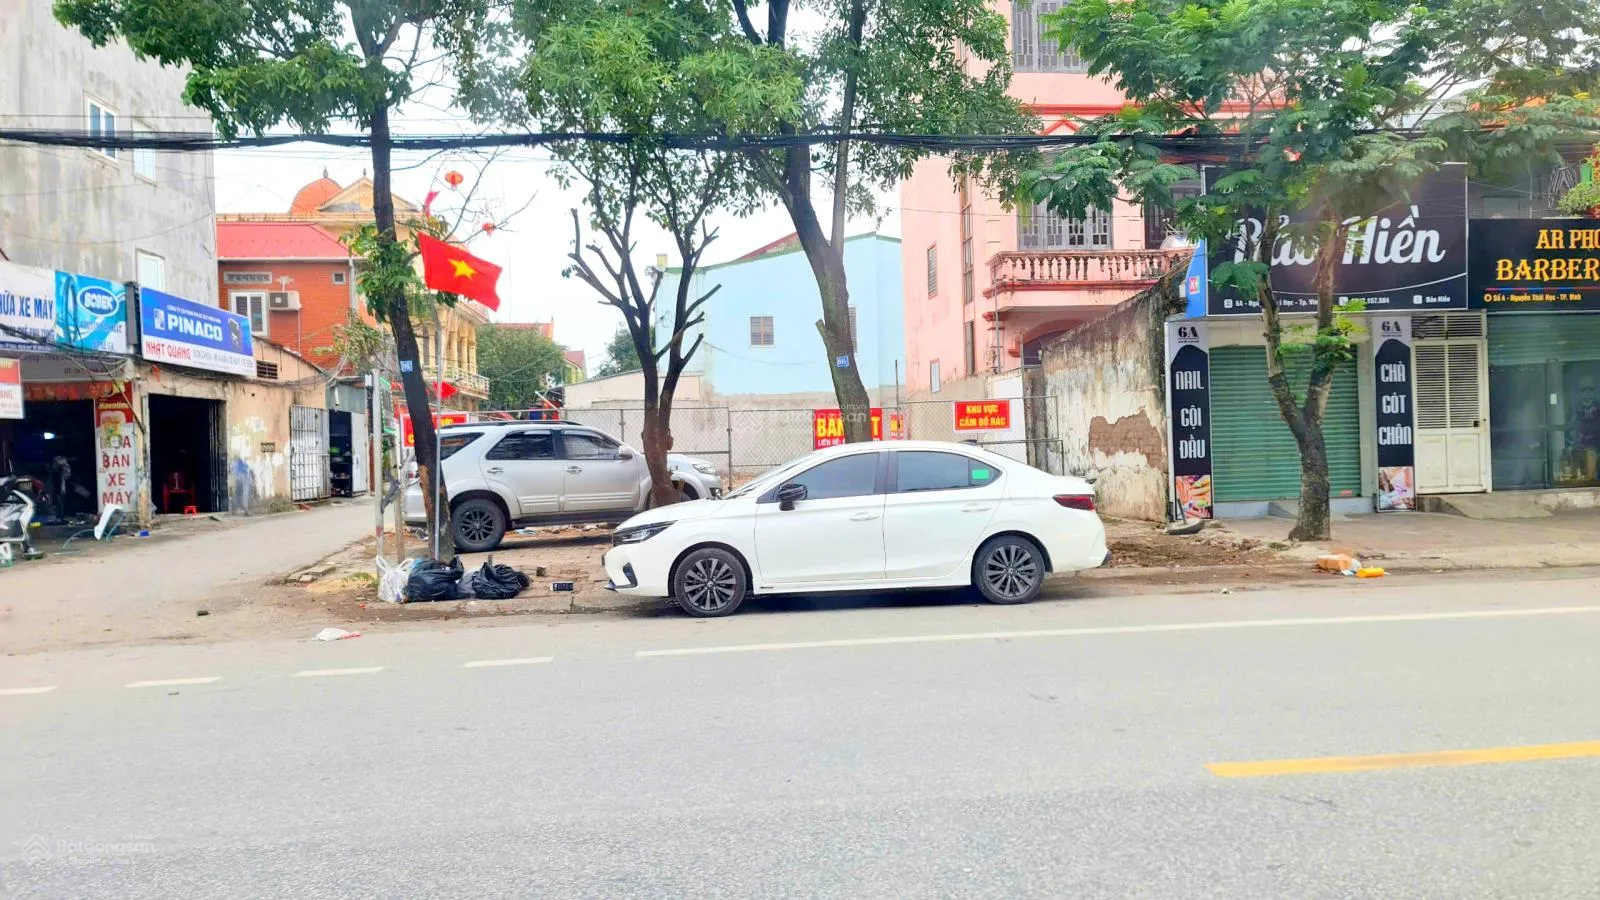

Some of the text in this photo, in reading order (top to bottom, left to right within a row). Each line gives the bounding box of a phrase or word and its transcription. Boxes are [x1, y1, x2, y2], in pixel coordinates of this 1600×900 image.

[1337, 205, 1447, 266] Hiền
[1535, 229, 1565, 249] AR
[1495, 258, 1600, 281] BARBER
[19, 296, 31, 318] XE
[34, 294, 54, 320] MÁY
[1569, 293, 1582, 301] Vinh
[167, 313, 223, 341] PINACO
[1178, 326, 1198, 338] 6A
[1381, 320, 1401, 331] 6A
[1175, 371, 1205, 390] NAIL
[1380, 361, 1406, 382] CHÀ
[966, 404, 999, 415] KHU VỰC
[1378, 423, 1412, 445] CHÂN
[1179, 434, 1206, 459] ĐẦU
[108, 473, 126, 487] XE
